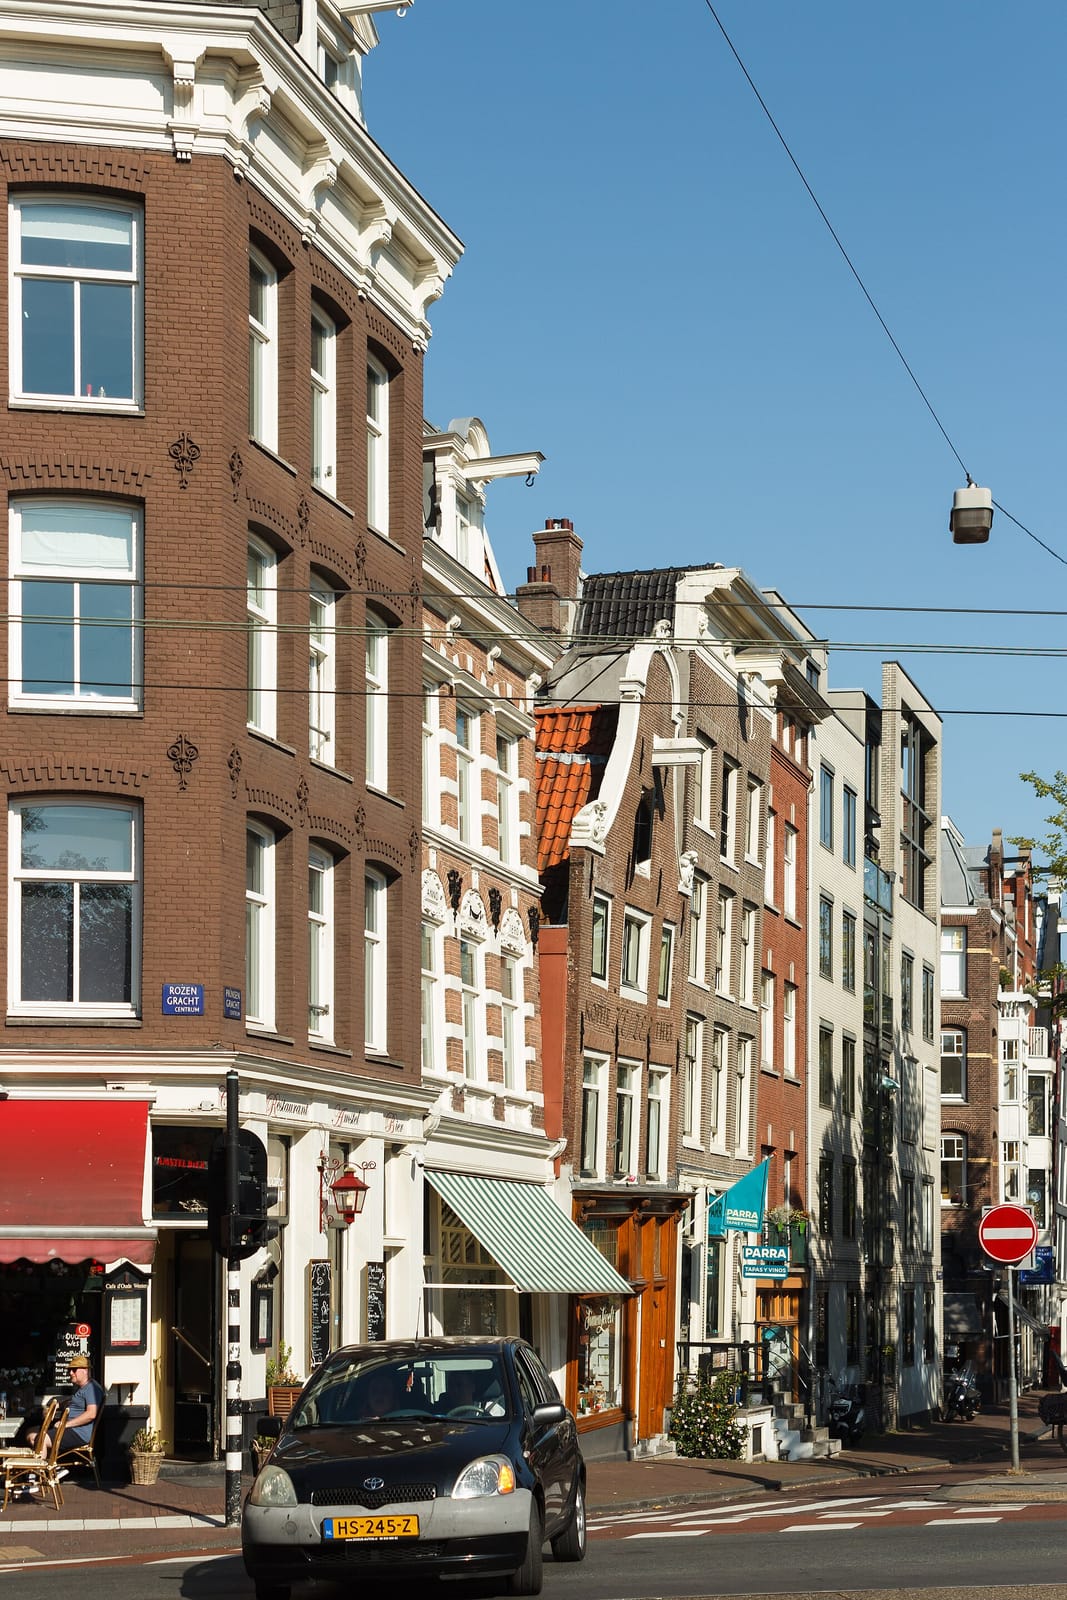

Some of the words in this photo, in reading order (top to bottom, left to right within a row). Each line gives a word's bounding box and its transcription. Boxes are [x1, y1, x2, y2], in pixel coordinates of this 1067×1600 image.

[169, 986, 197, 995] ROZEN
[166, 996, 200, 1006] GRACHT
[266, 1092, 309, 1118] Restaurant
[331, 1103, 362, 1128] Amstel
[384, 1111, 405, 1134] Bier
[726, 1208, 758, 1219] PARRA
[745, 1248, 787, 1259] PARRA
[338, 1518, 412, 1536] HS-245-Z
